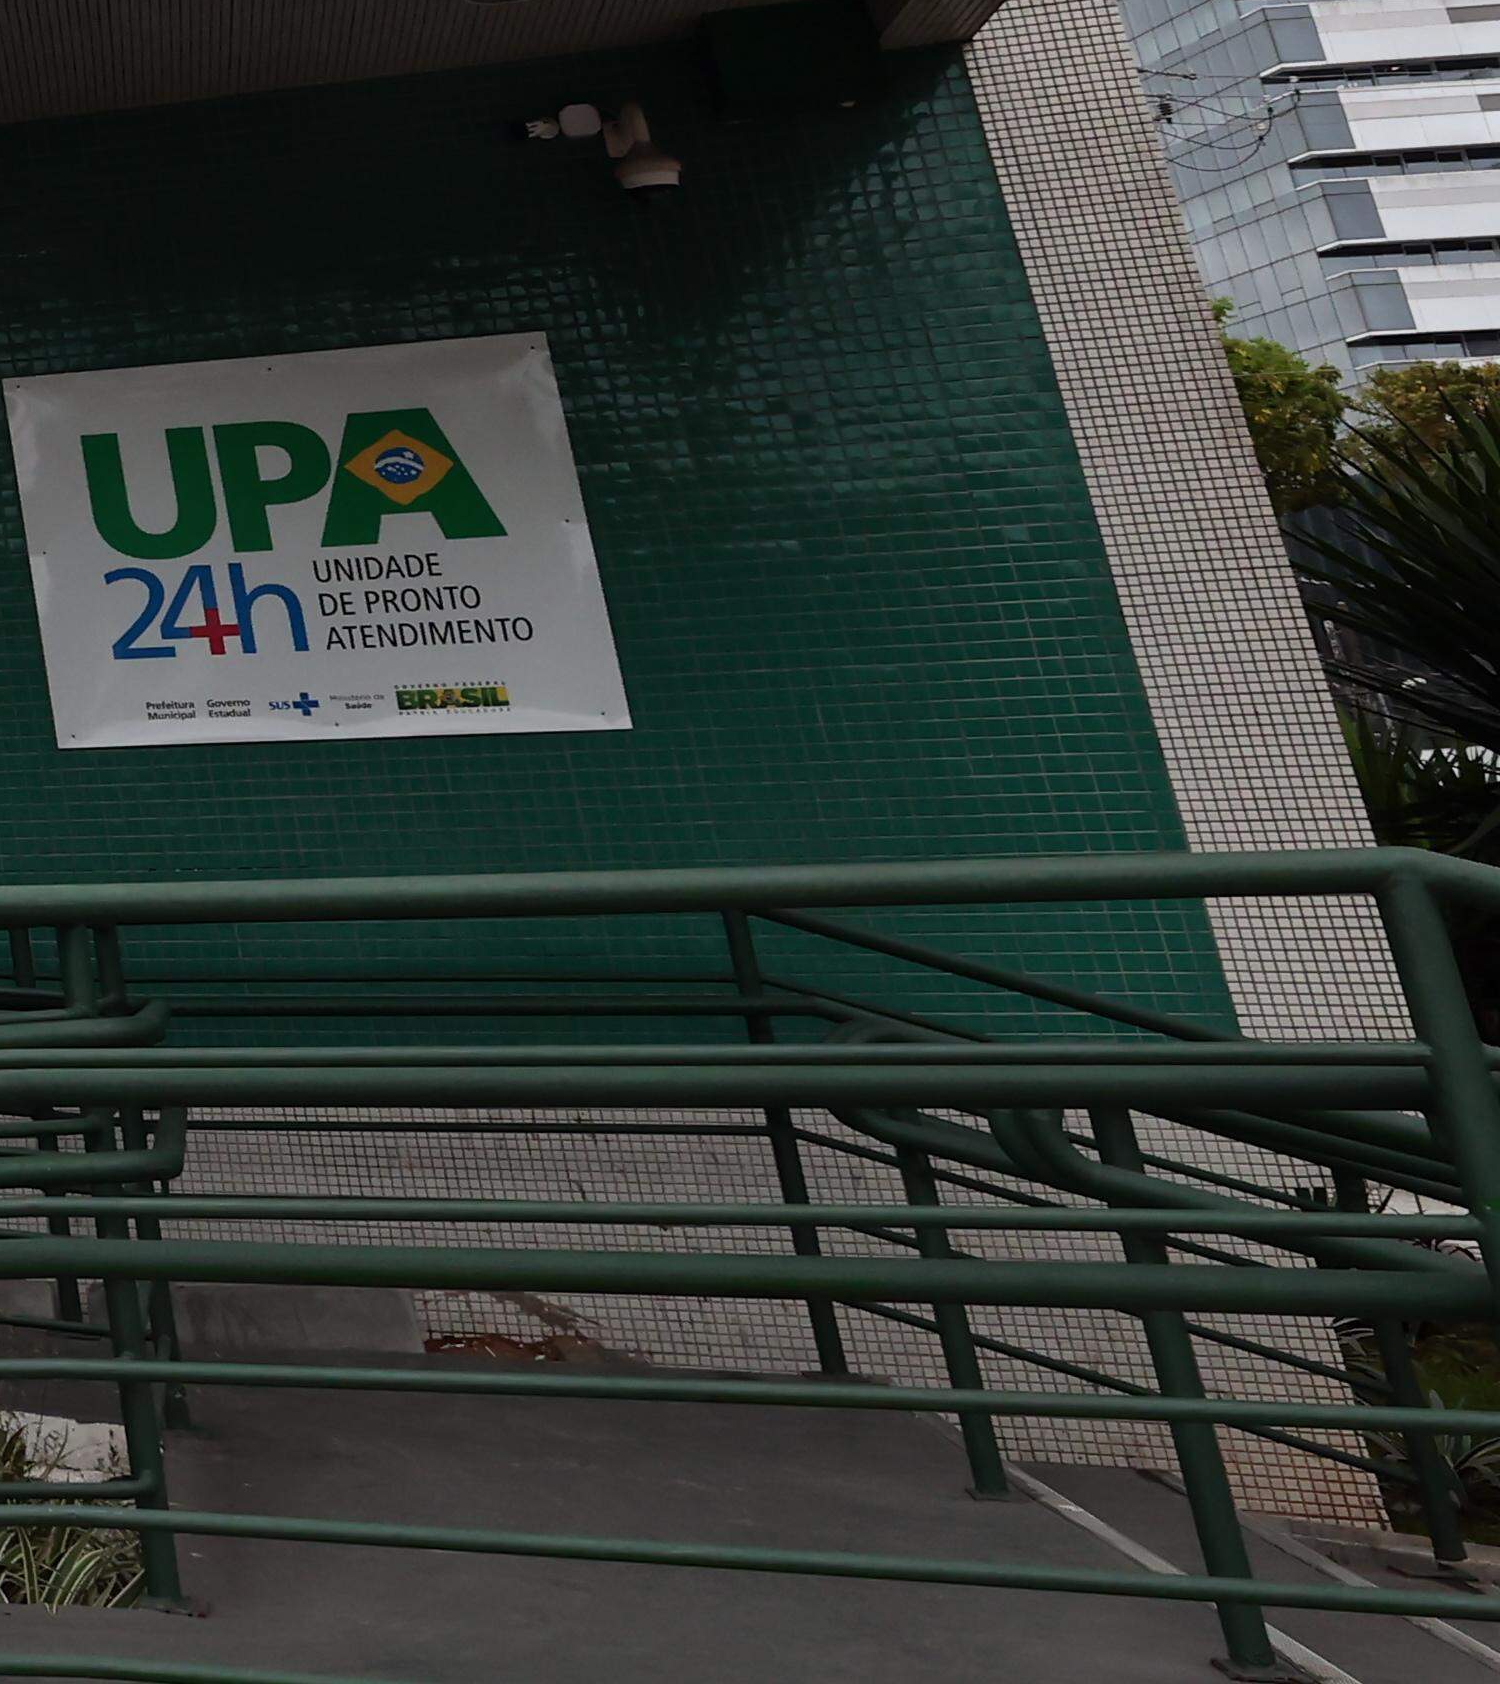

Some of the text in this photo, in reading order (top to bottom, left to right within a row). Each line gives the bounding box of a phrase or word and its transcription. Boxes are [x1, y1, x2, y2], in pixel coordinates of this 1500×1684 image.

[80, 407, 509, 560] UPA
[312, 552, 443, 584] UNIDADE
[103, 562, 310, 660] 24h
[318, 584, 482, 617] DE PRONTO
[325, 616, 535, 652] ATENDIMENTO
[145, 701, 195, 711] Prefeitura
[206, 698, 251, 708] Governo
[268, 700, 292, 711] SUS
[395, 686, 510, 711] BRASIL
[147, 710, 197, 721] Municipal
[208, 708, 252, 718] Estadual
